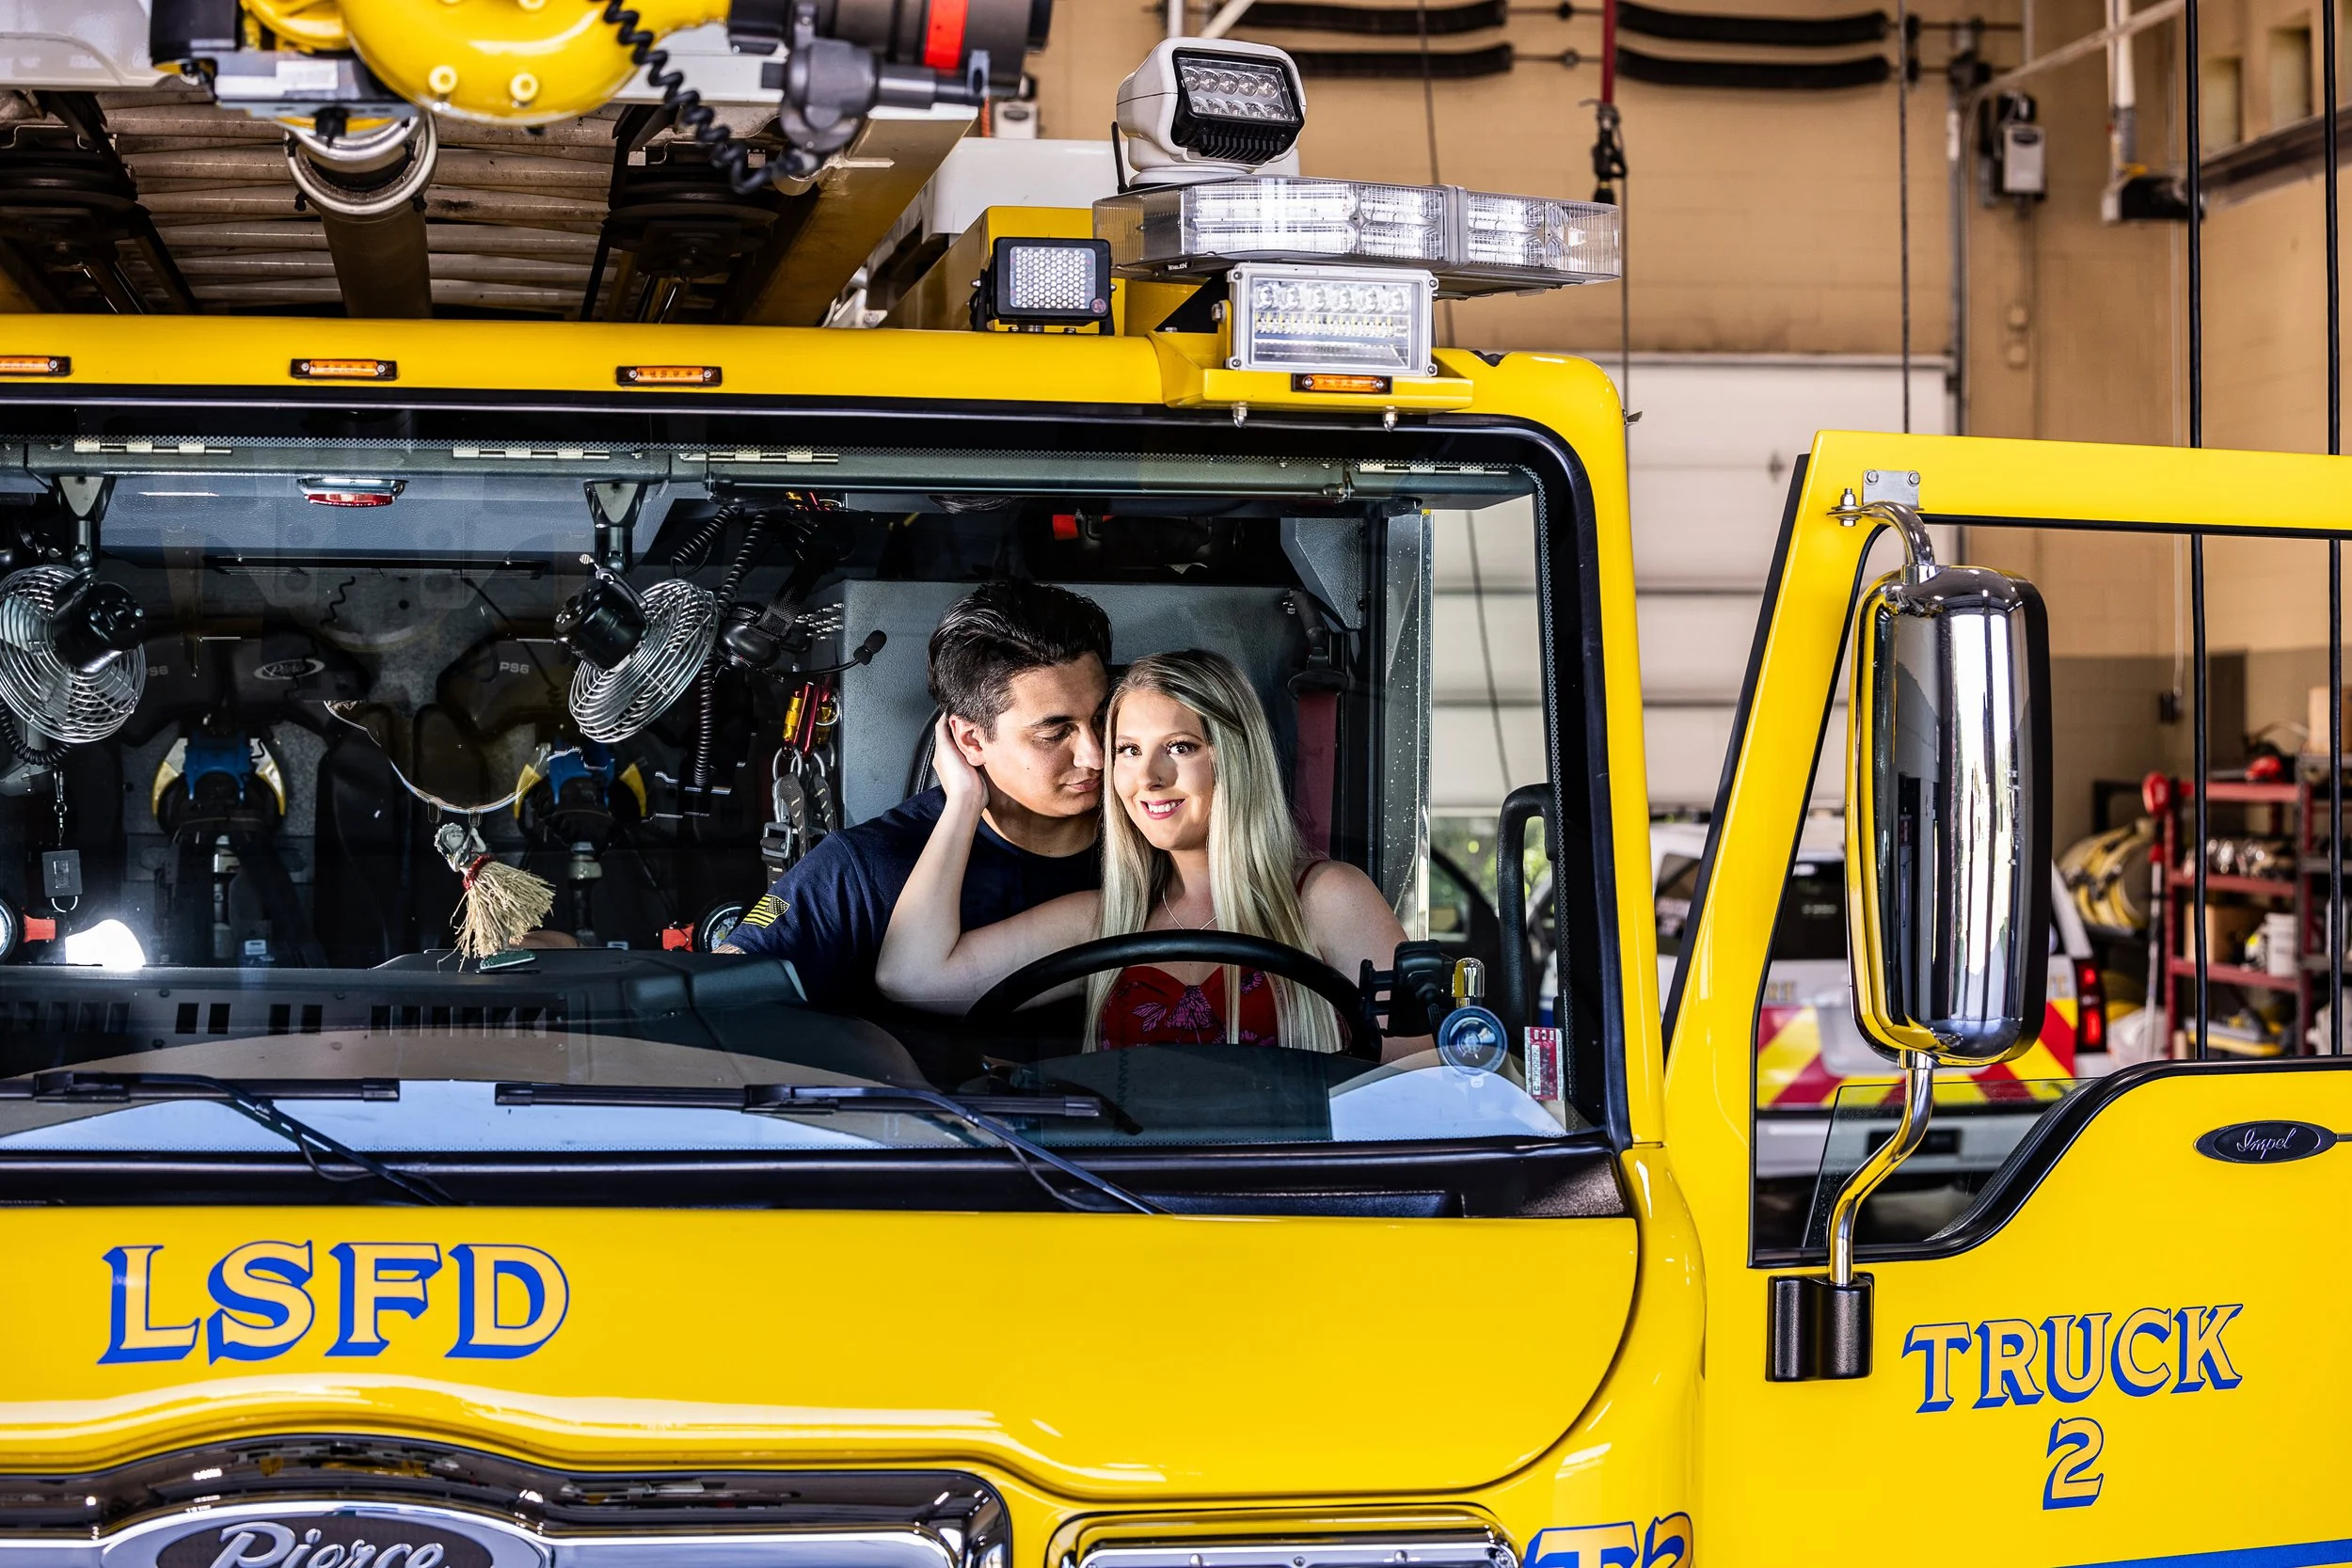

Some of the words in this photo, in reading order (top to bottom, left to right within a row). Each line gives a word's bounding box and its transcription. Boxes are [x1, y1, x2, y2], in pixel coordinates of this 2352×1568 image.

[2236, 1127, 2297, 1160] Impel
[96, 1240, 569, 1366] LSFD
[1901, 1304, 2244, 1414] TRUCK
[2042, 1417, 2105, 1511] 2
